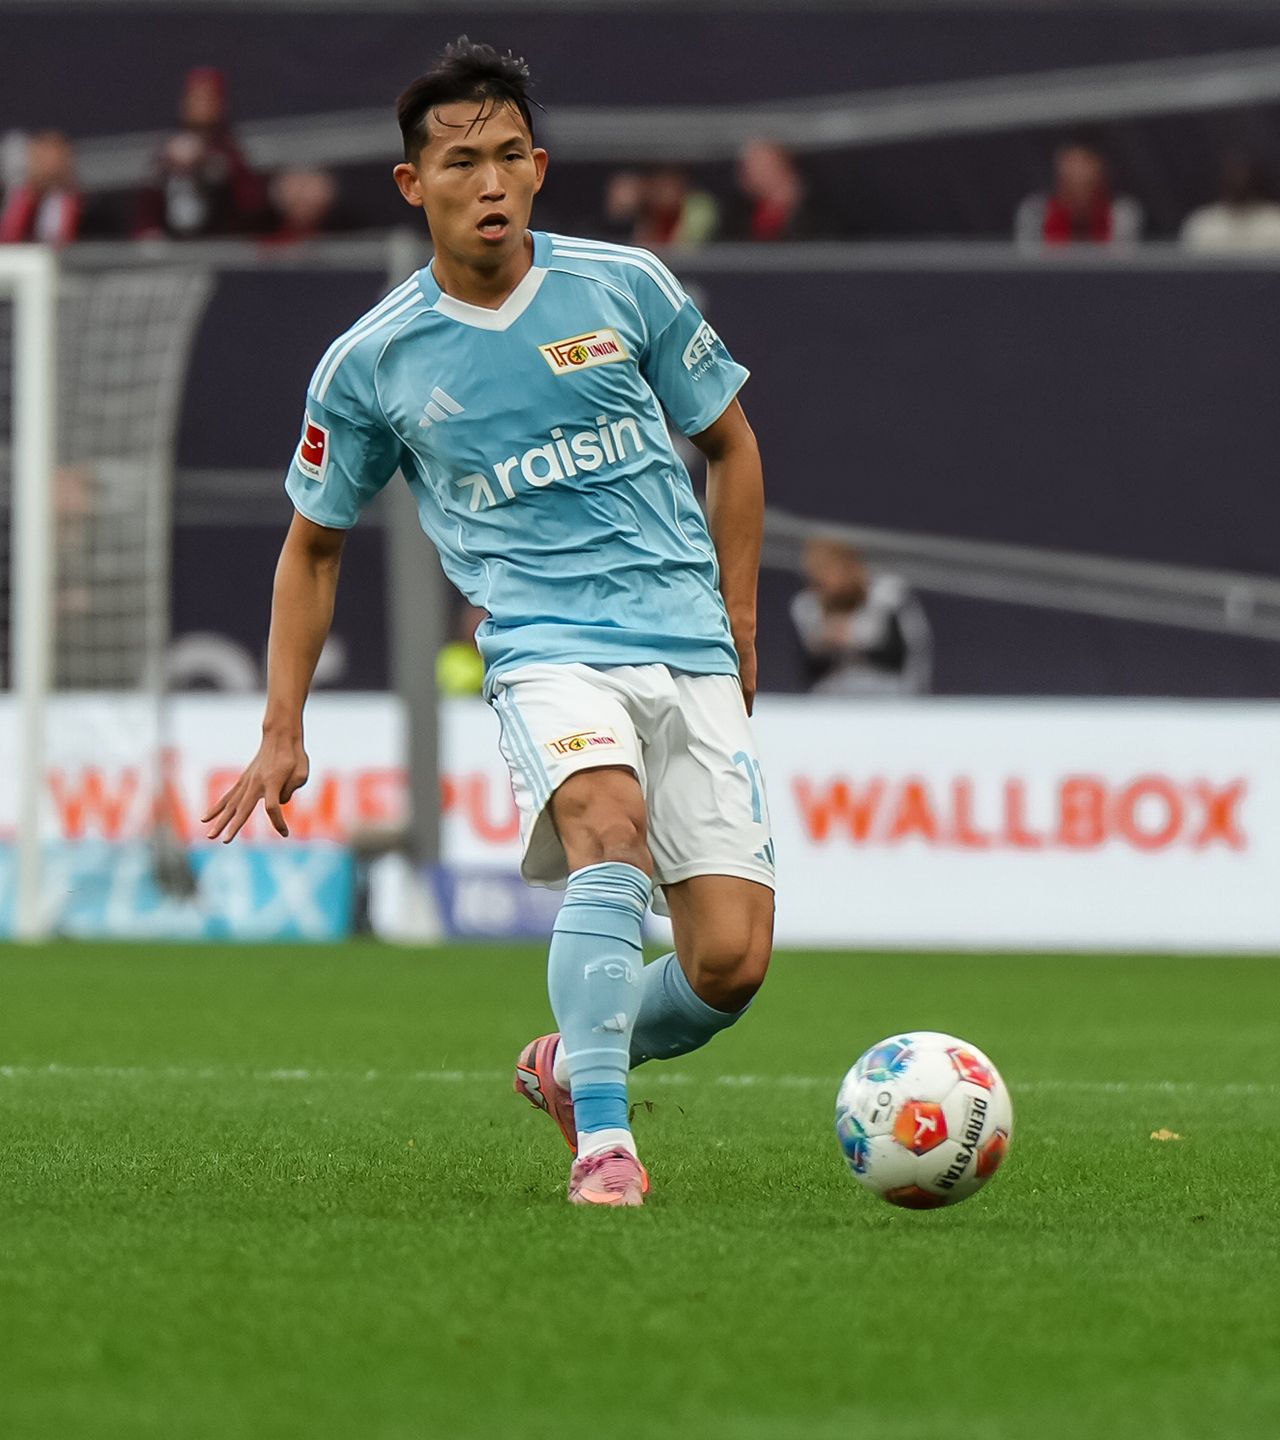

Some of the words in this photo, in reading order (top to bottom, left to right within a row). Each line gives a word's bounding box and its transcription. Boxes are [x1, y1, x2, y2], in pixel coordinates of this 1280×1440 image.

[587, 341, 619, 358] UNION
[683, 325, 719, 371] KER
[493, 414, 644, 500] raisin
[791, 774, 1248, 852] WALLBOX
[936, 1098, 987, 1190] DERBYSTAR
